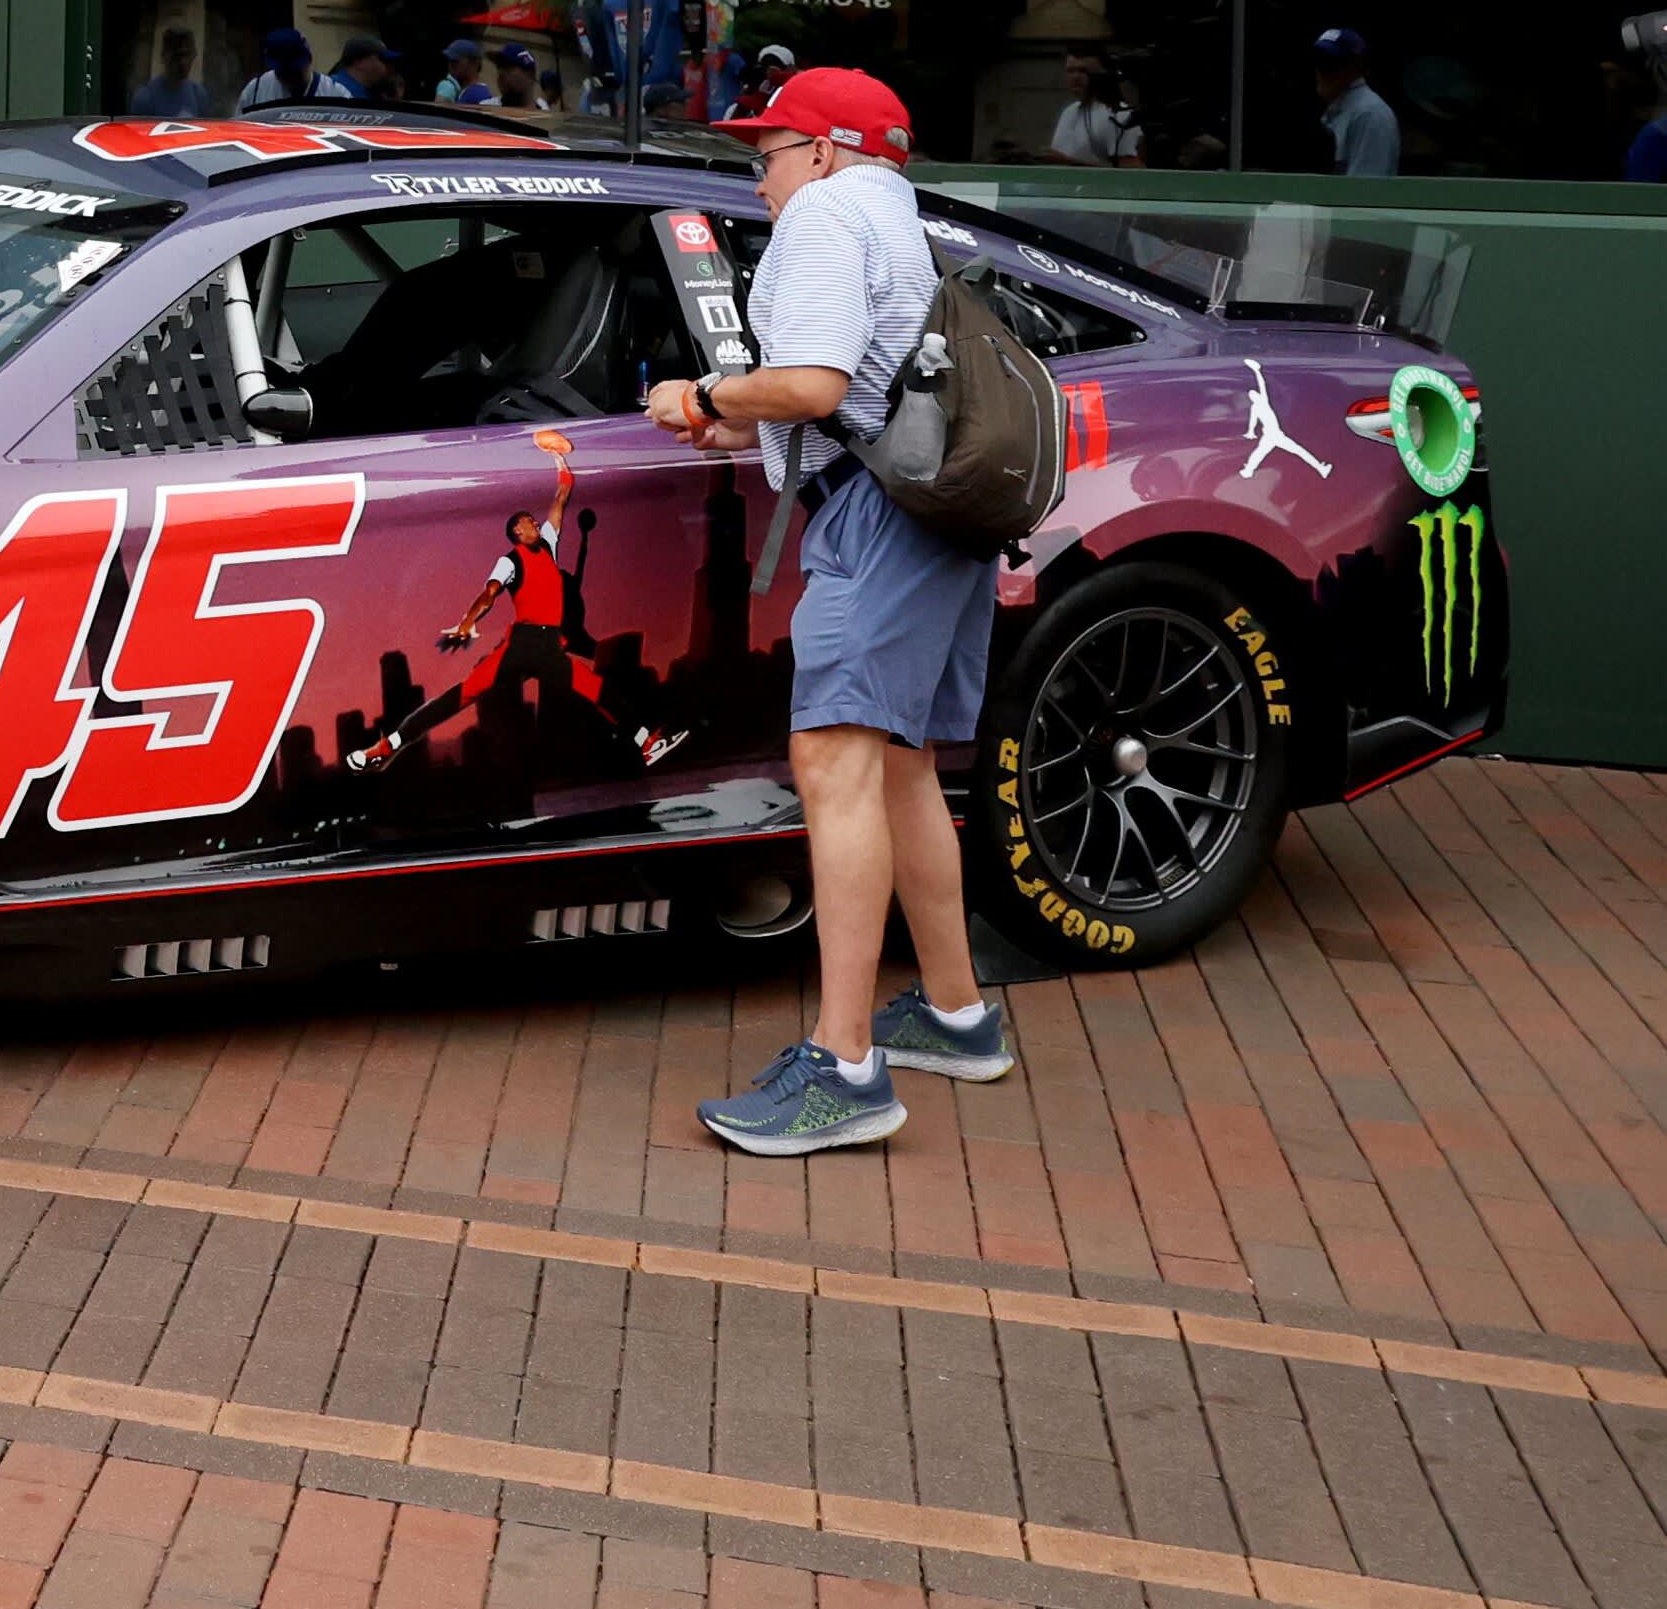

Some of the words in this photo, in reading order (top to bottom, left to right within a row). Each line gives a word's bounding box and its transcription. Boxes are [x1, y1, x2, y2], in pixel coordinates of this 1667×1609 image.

[415, 176, 501, 195] TYLER
[504, 175, 610, 196] REDDICK
[1064, 263, 1183, 320] MoneyLion
[1224, 606, 1292, 727] EAGLE
